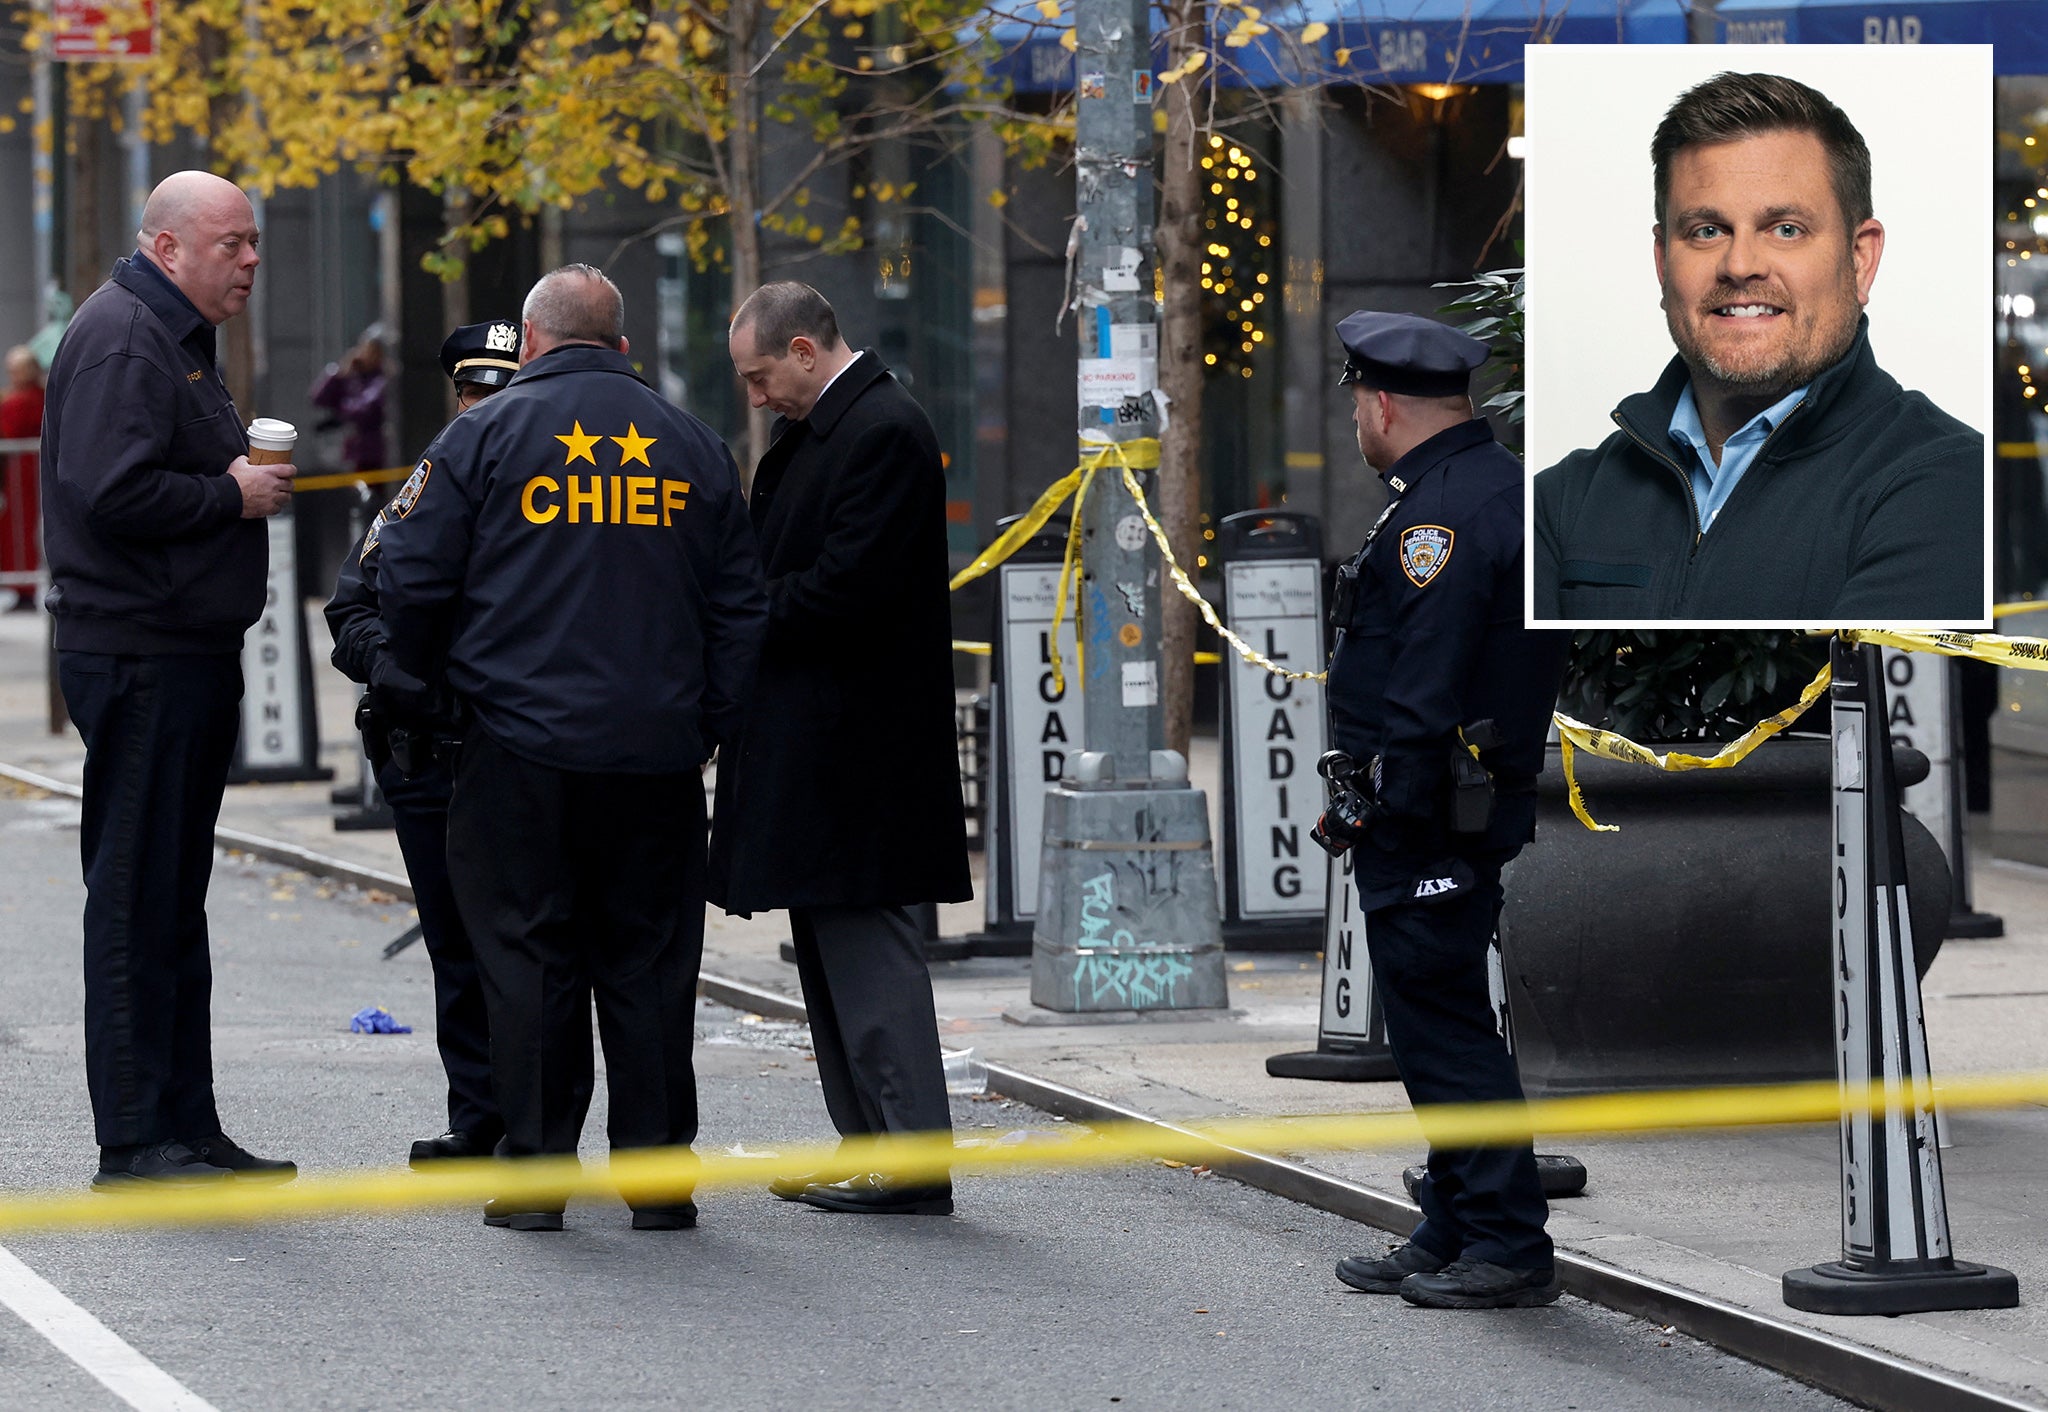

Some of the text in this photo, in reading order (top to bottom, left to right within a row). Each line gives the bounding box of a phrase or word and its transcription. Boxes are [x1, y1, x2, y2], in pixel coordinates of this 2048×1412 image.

[1863, 16, 1923, 44] BAR
[1379, 30, 1427, 71] BAR
[521, 475, 691, 527] CHIEF
[1404, 535, 1448, 547] DEPARTMENT
[1413, 528, 1439, 537] POLICE
[1403, 554, 1417, 577] CITY OF
[1425, 548, 1448, 579] NEW YORK
[2008, 642, 2041, 660] CROSS
[1264, 629, 1301, 898] LOADING
[1836, 805, 1857, 1226] LOADING
